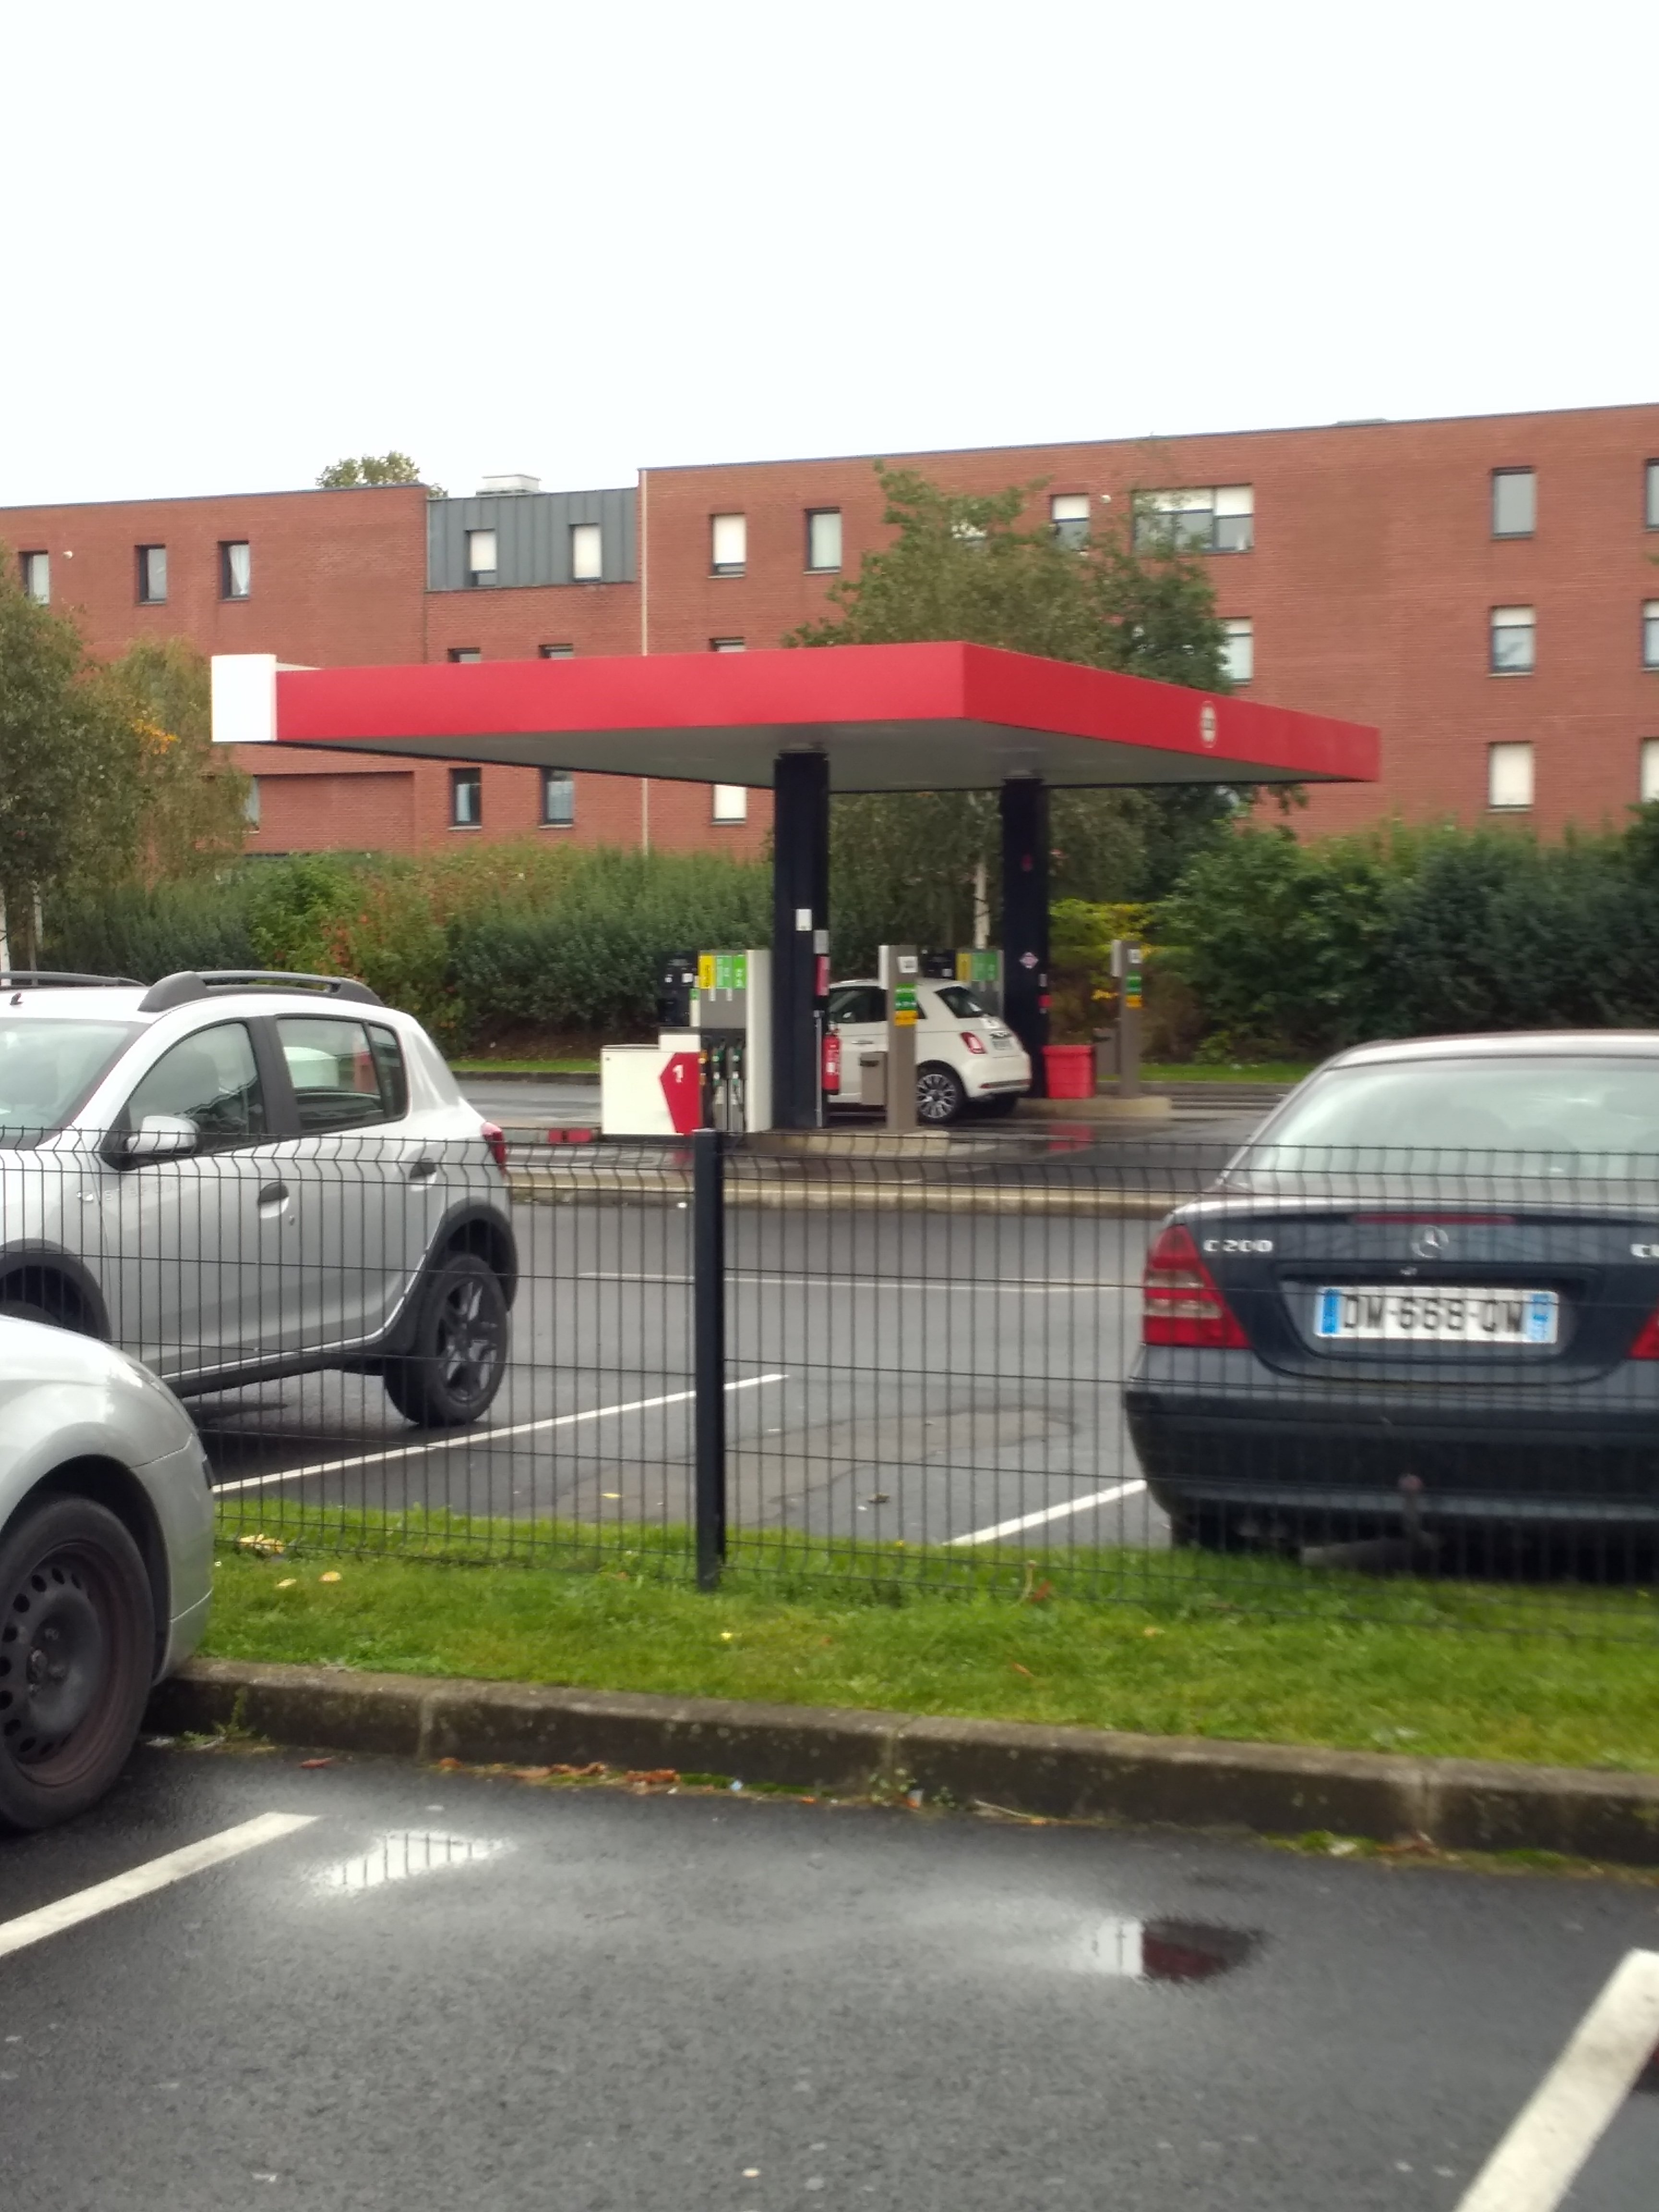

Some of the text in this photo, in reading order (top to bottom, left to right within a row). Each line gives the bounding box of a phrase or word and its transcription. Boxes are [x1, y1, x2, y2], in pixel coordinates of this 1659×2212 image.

[672, 1064, 684, 1083] 1
[1203, 1239, 1273, 1252] C 200
